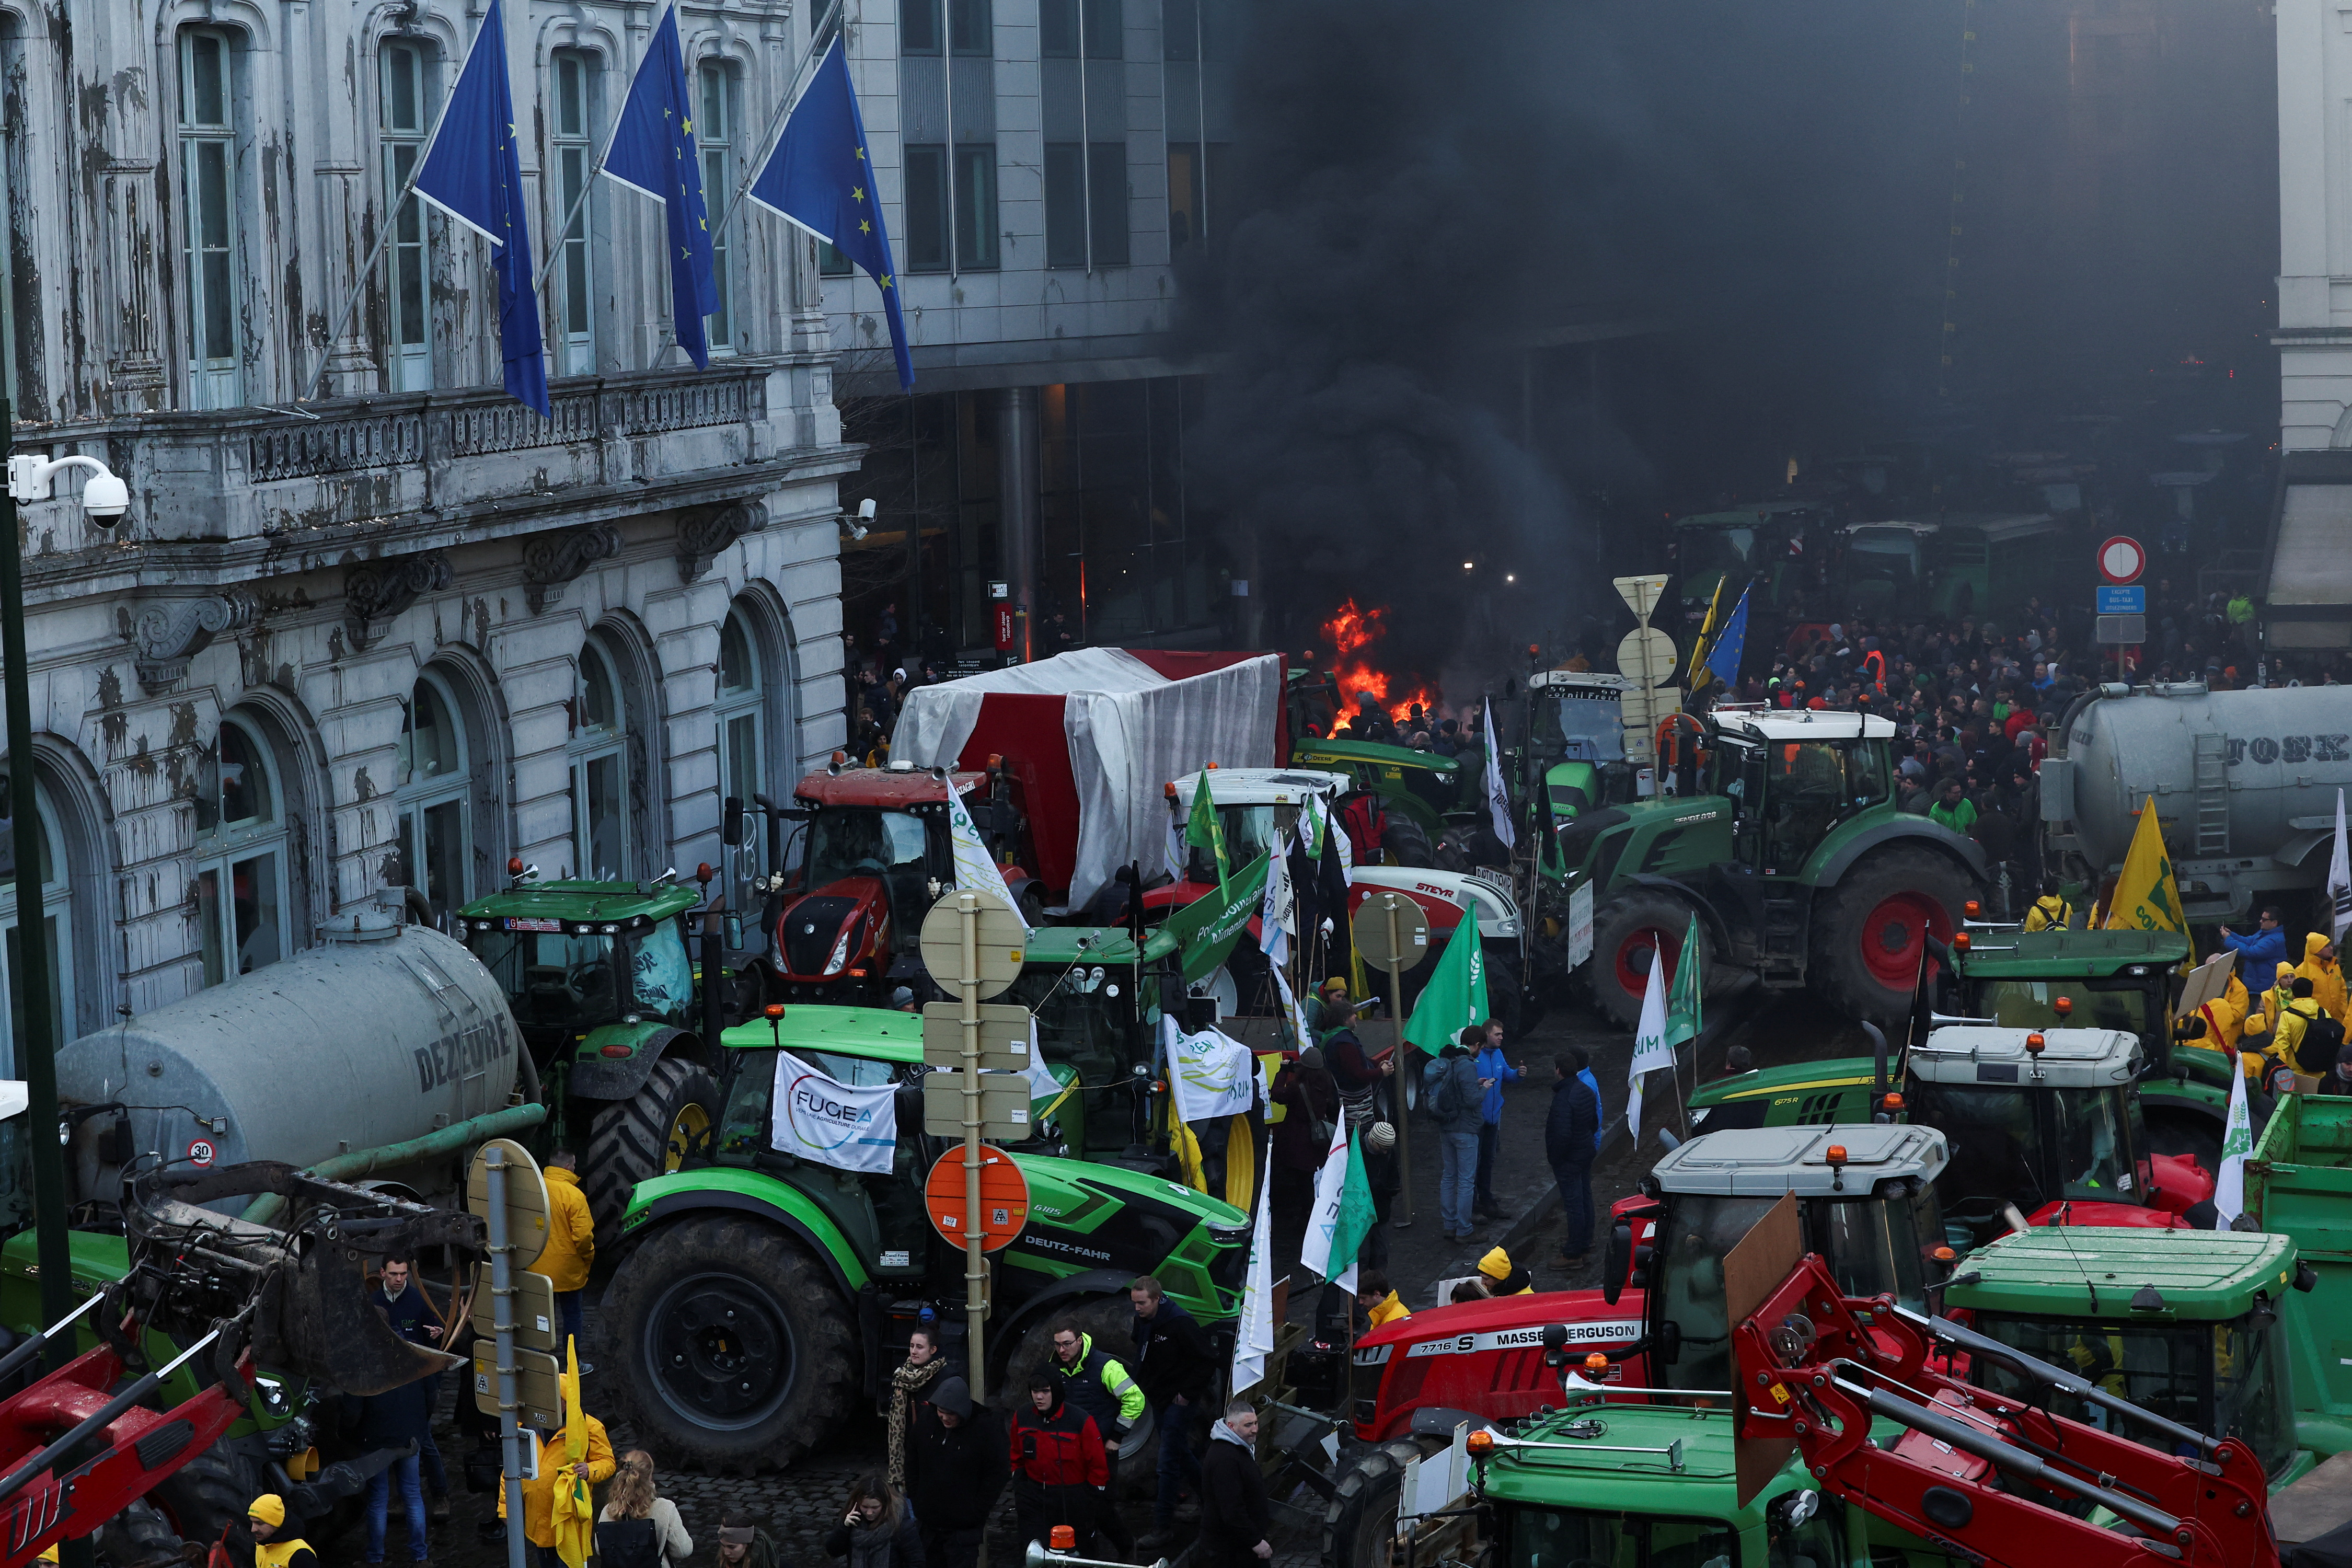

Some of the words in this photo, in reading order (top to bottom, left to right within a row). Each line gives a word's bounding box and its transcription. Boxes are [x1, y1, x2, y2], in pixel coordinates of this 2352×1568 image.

[1415, 882, 1455, 898] STEYR
[510, 919, 516, 927] G
[414, 1012, 511, 1094] DEZEURE
[797, 1090, 872, 1124] FUGEA
[1774, 1098, 1791, 1106] 6175
[816, 1115, 854, 1129] AGRICULTURE
[194, 1145, 209, 1156] 30
[1034, 1204, 1062, 1216] 6185
[1025, 1235, 1111, 1261] DEUTZ-FAHR
[1420, 1342, 1452, 1354] 7716
[1457, 1335, 1474, 1352] S
[1497, 1332, 1544, 1346] MASSE
[1568, 1325, 1635, 1339] ERGUSON
